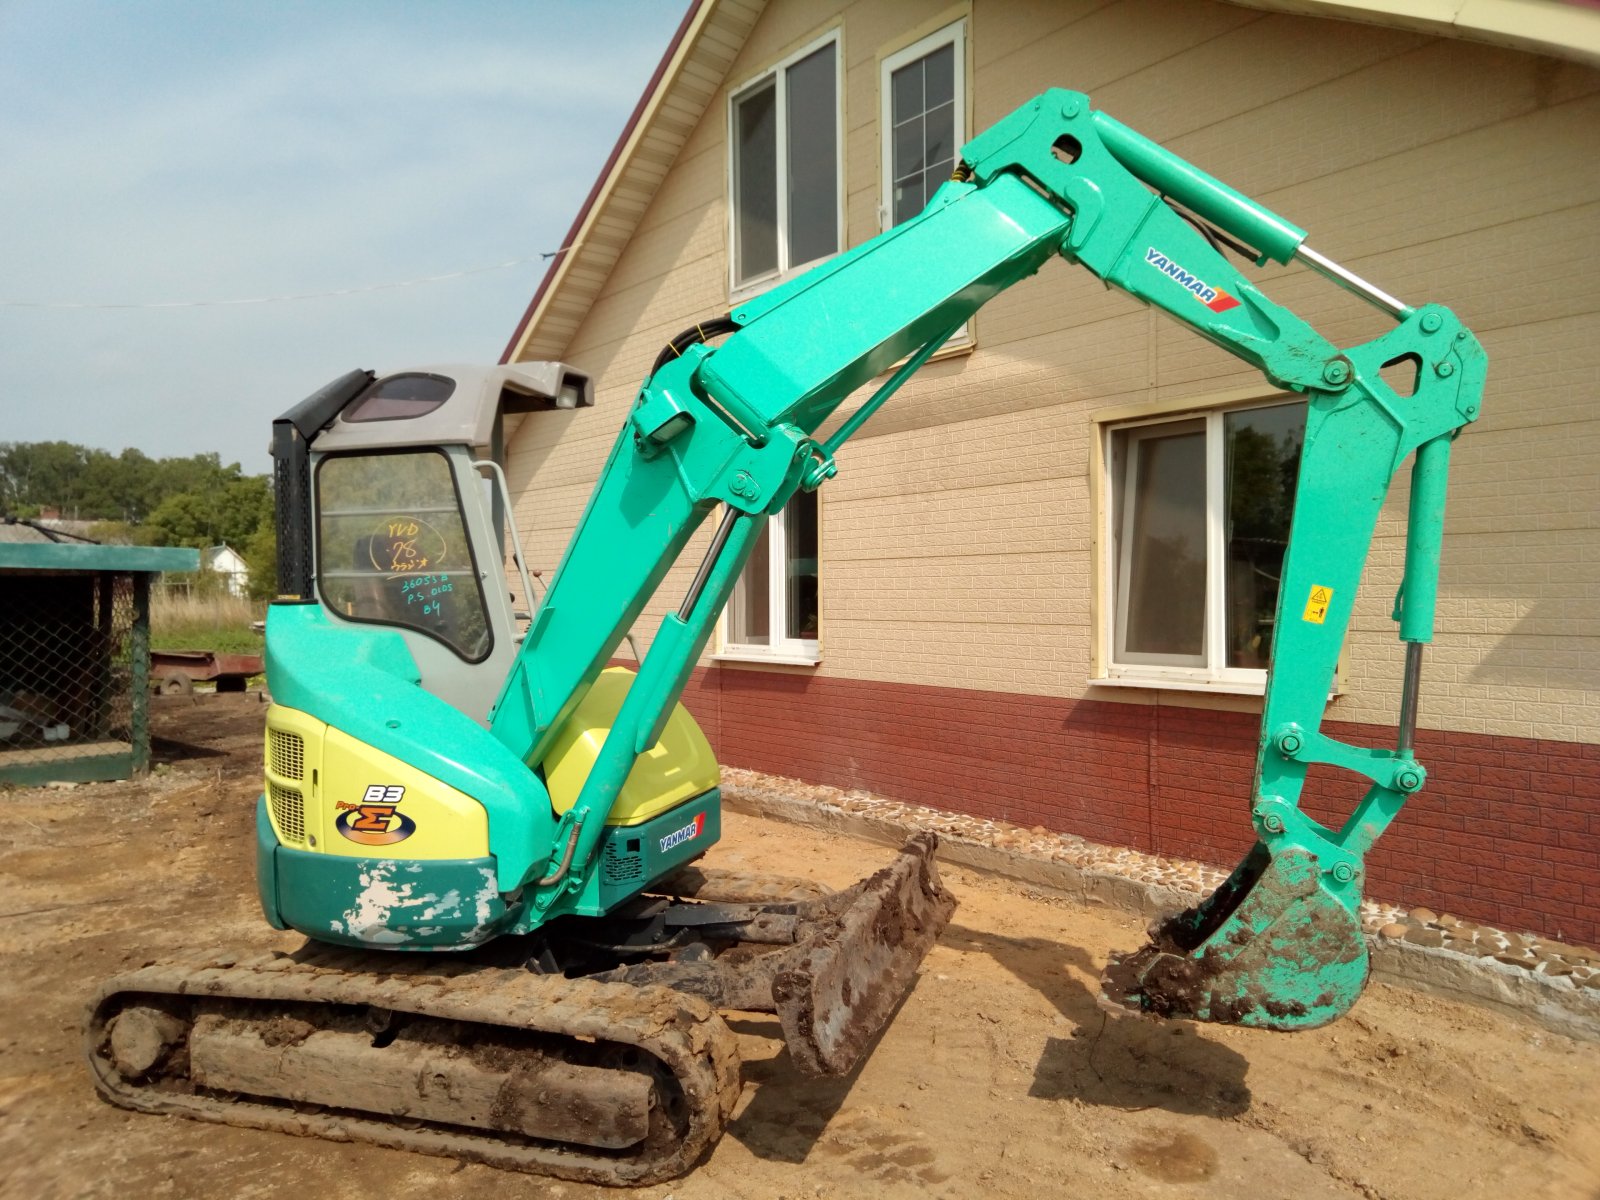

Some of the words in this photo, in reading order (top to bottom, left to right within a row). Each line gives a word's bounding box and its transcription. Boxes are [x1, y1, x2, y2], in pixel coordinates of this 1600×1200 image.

[1145, 247, 1218, 303] YANMAR
[362, 785, 406, 803] B3
[660, 821, 697, 853] YANMAR
